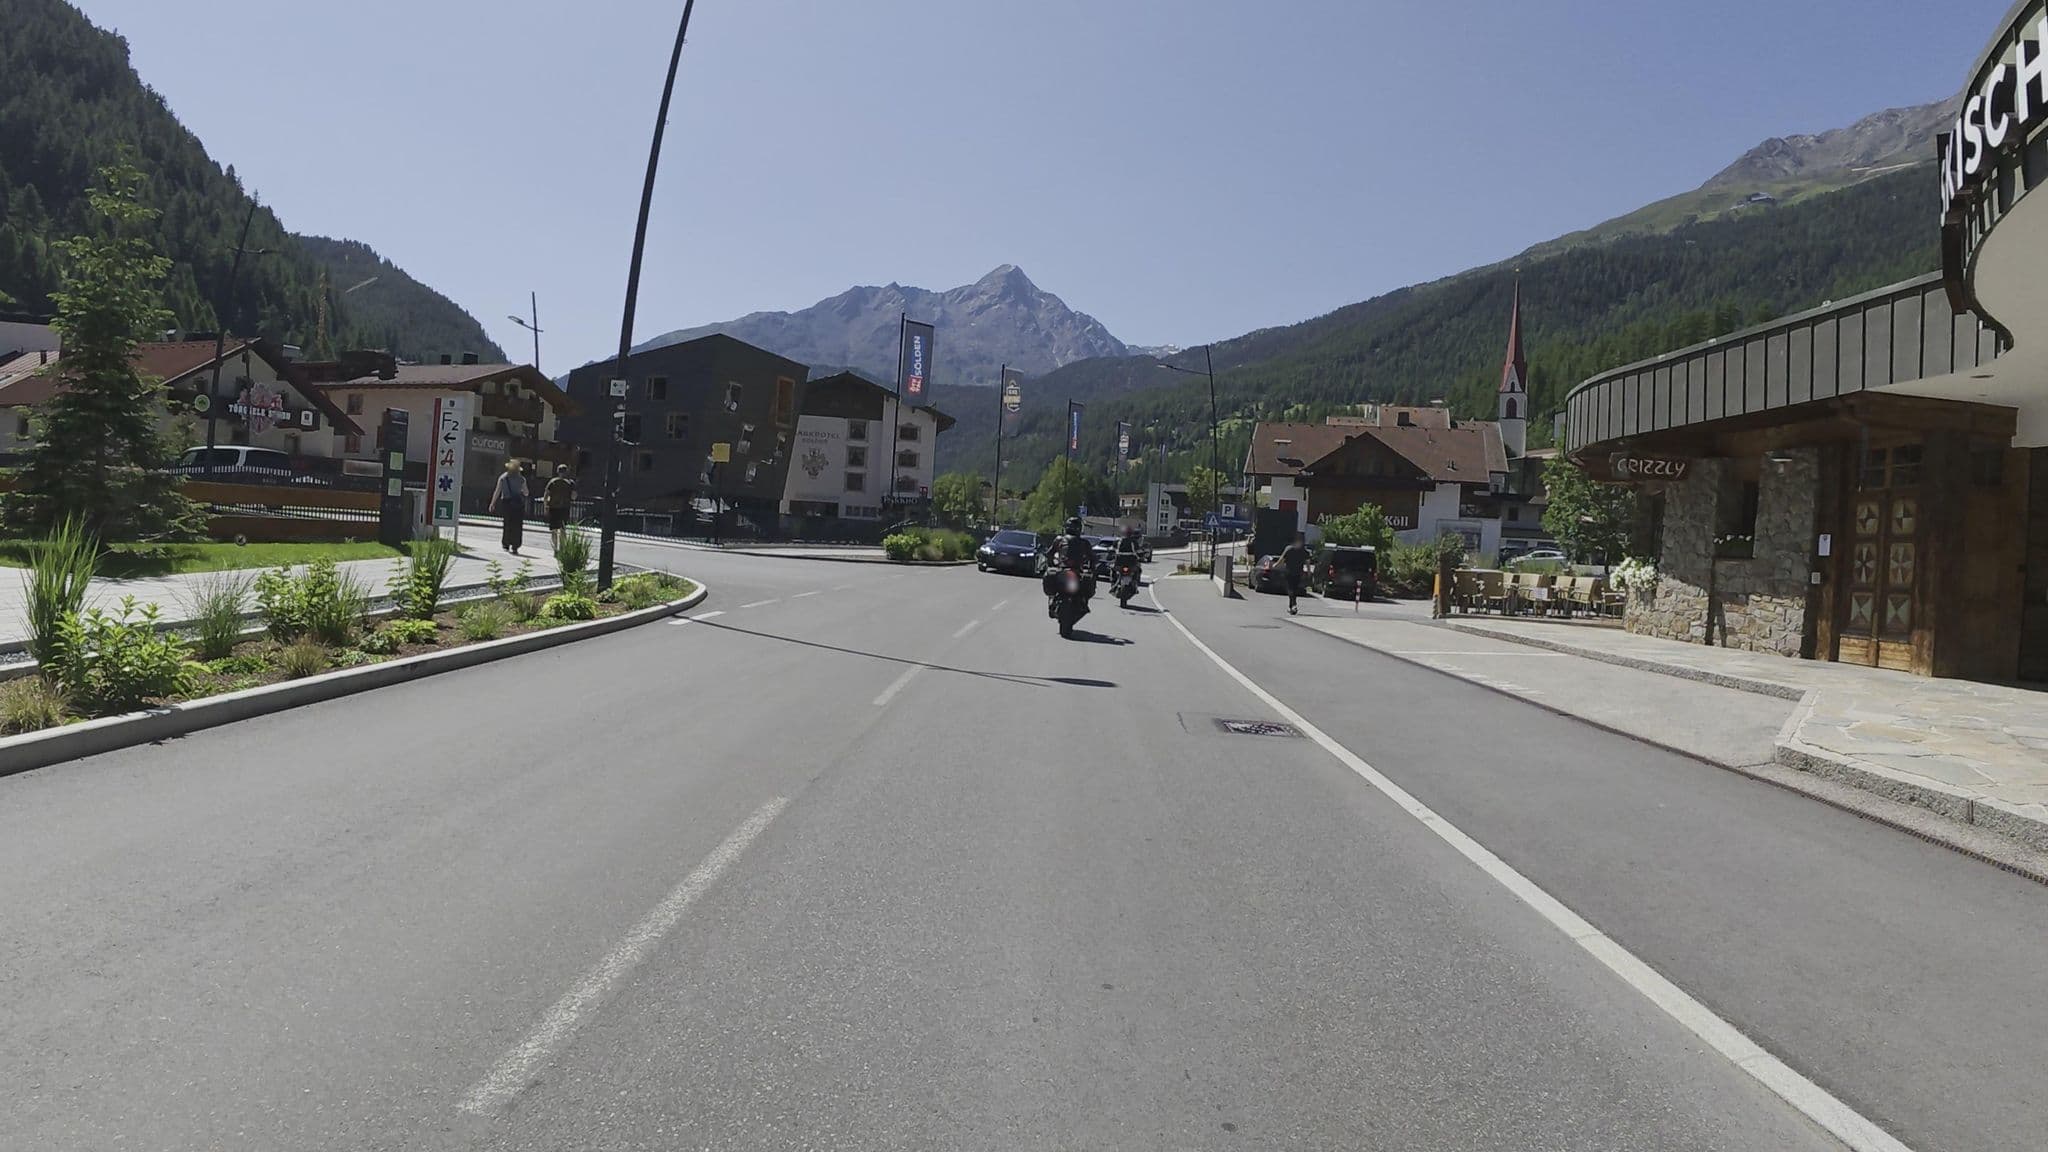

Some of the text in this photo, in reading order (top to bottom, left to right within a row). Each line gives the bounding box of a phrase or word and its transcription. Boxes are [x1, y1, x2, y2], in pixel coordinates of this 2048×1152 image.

[913, 335, 922, 376] SÖLDEN
[1617, 458, 1686, 478] GRIZZLY
[1225, 505, 1232, 515] P
